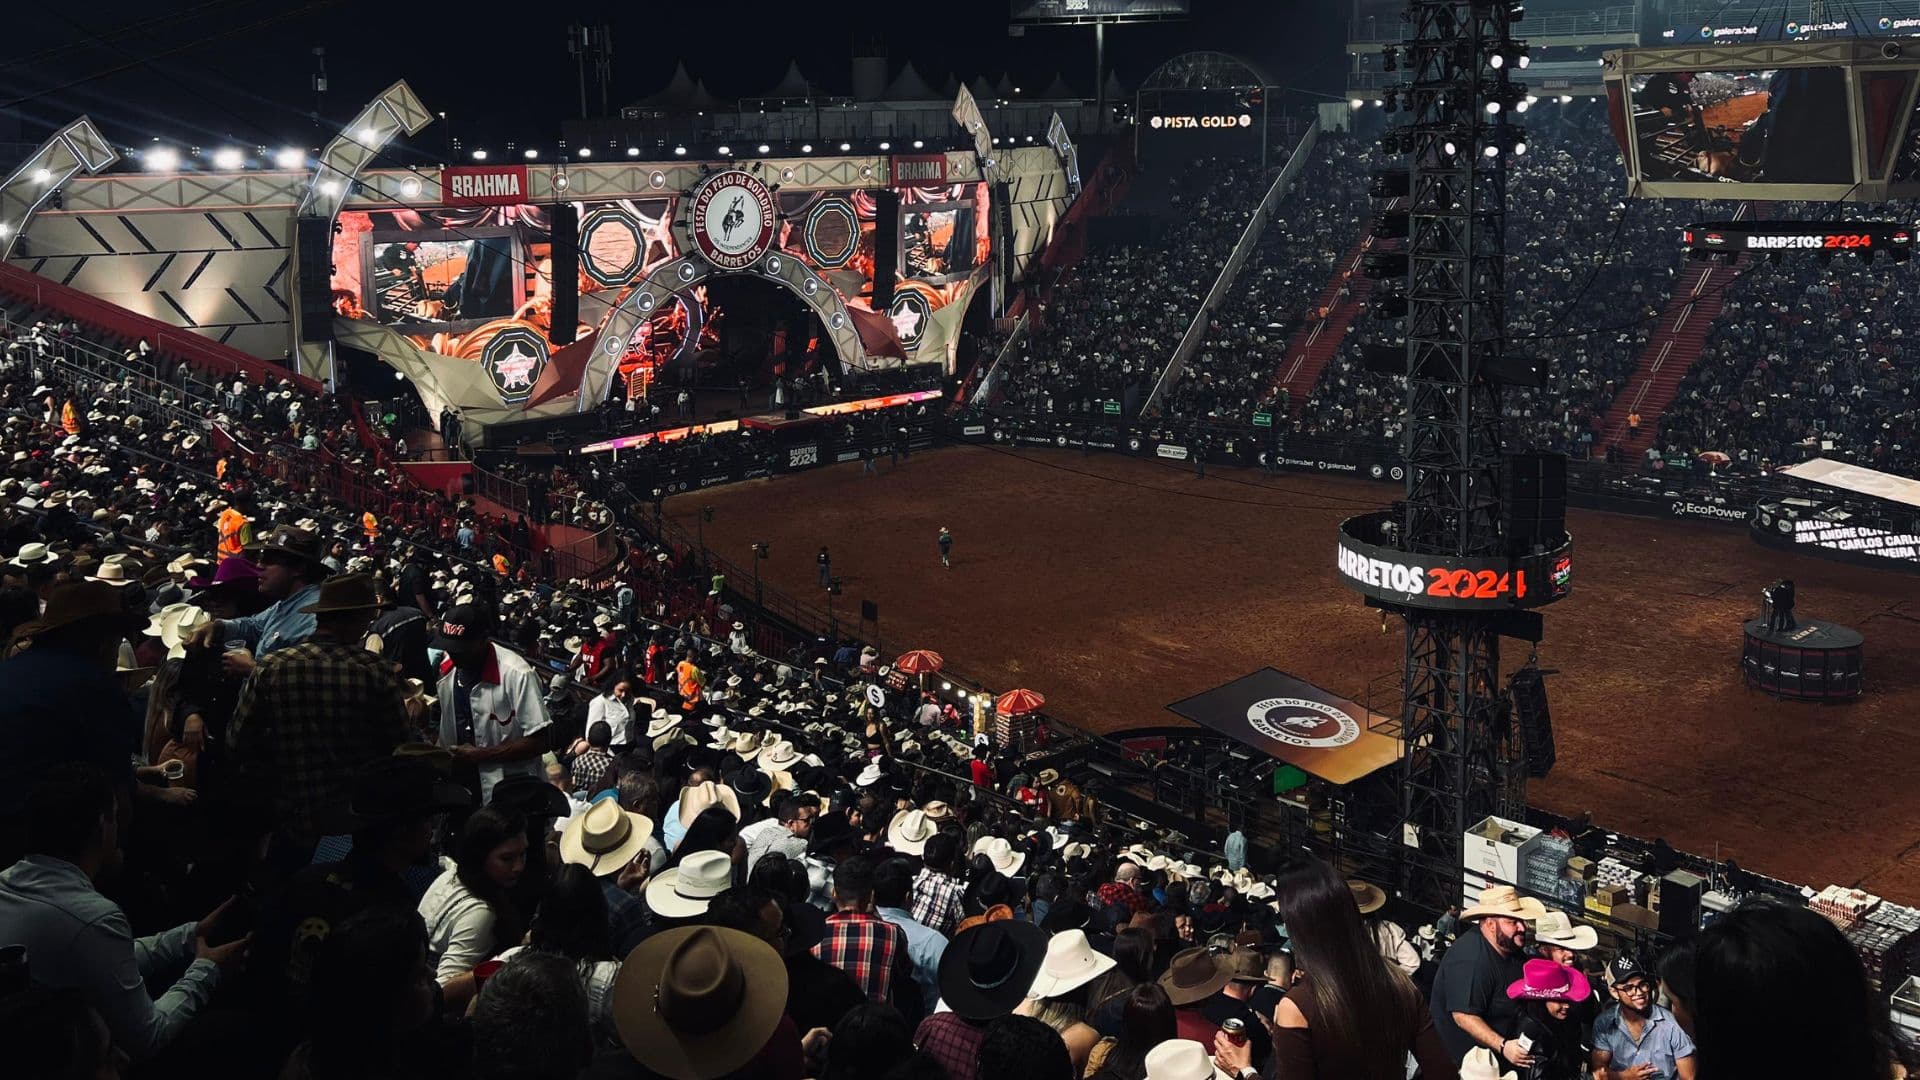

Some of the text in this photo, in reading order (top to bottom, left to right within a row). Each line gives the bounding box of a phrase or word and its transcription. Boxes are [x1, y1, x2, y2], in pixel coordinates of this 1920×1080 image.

[1164, 116, 1237, 128] PISTA GOLD
[897, 160, 943, 180] BRAHMA
[451, 174, 521, 198] BRAHMA
[695, 204, 706, 233] FESTA
[702, 188, 713, 205] DO
[736, 174, 748, 186] DE
[746, 179, 773, 227] BOIADEIRO
[1747, 234, 1871, 248] BARRETOS 2024
[709, 244, 762, 267] BARRETOS
[789, 453, 817, 467] 2024
[1687, 502, 1747, 519] EcoPower
[1819, 528, 1857, 541] ANDRE
[1838, 537, 1883, 550] CARLOS
[1427, 567, 1527, 598] 2024
[1252, 718, 1311, 746] BARRETOS
